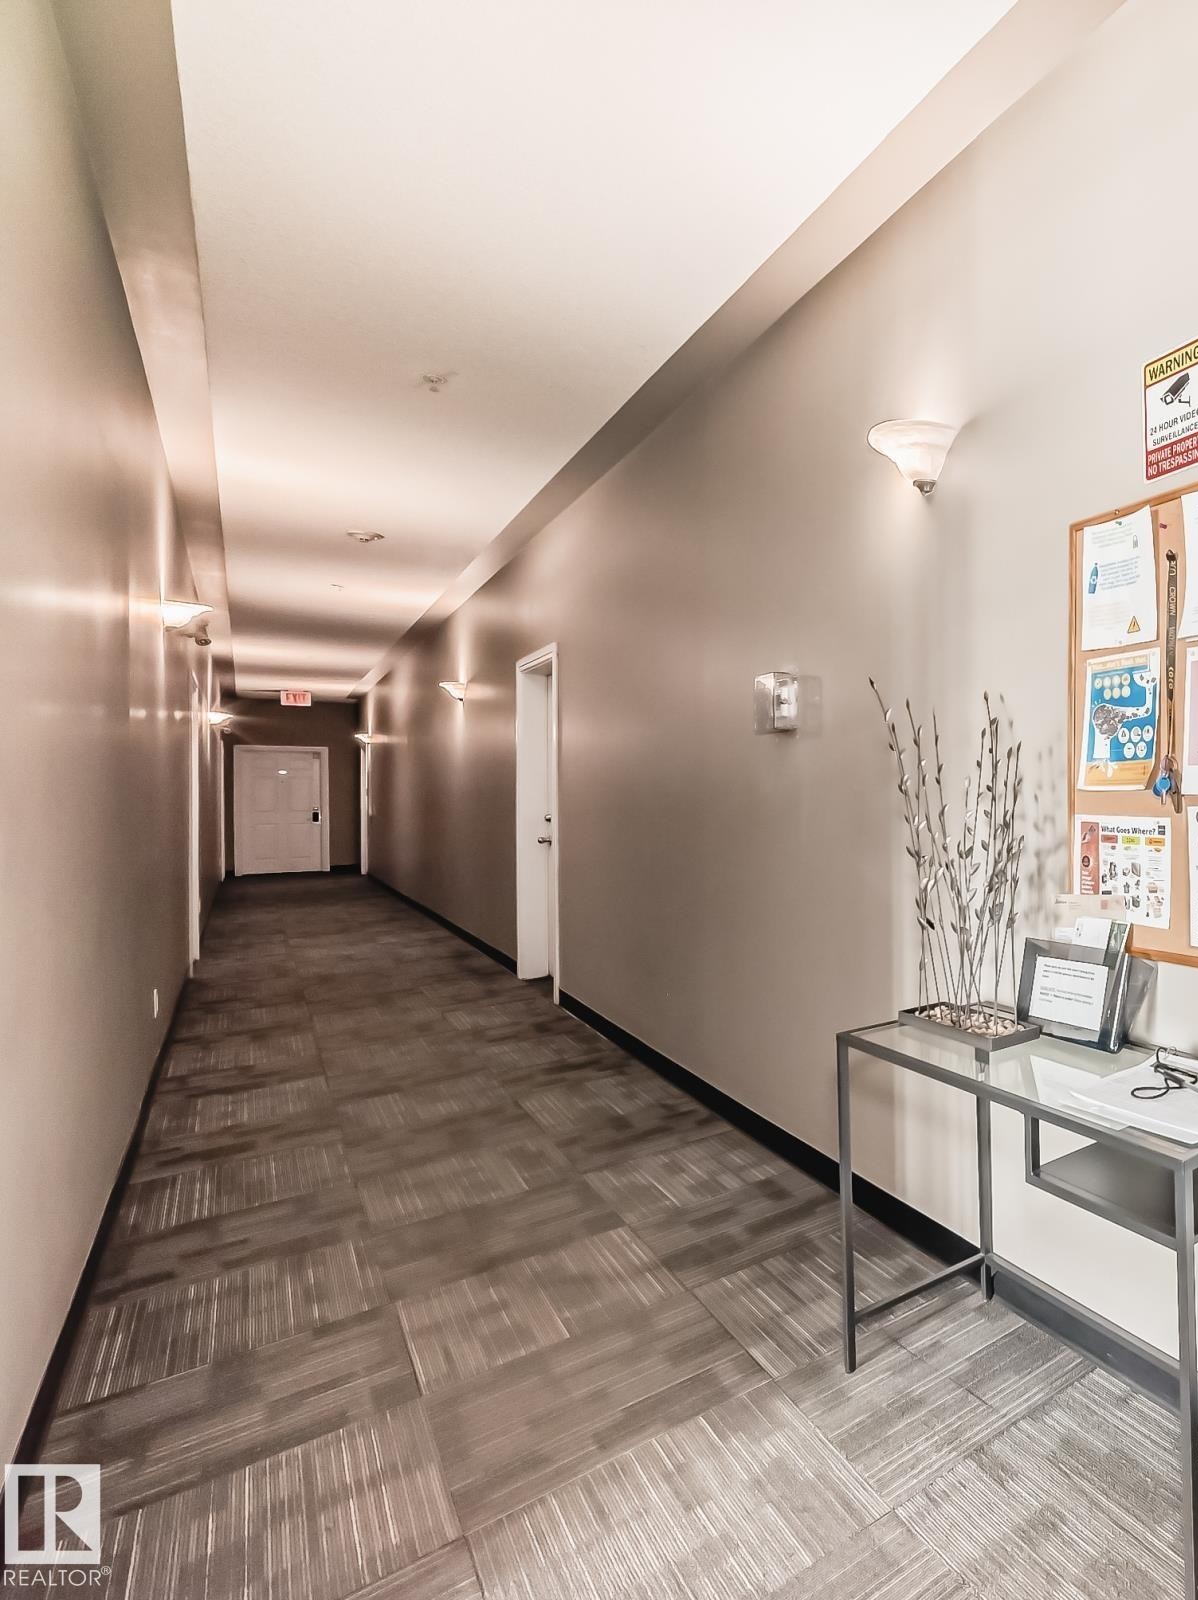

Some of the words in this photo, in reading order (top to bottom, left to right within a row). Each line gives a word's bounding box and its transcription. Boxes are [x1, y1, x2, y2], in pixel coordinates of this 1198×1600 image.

[1149, 426, 1157, 436] 24
[1158, 417, 1178, 433] HOUR
[1152, 421, 1198, 447] SURVEILLANCE
[1147, 446, 1172, 465] PRIVATE
[1147, 464, 1158, 476] NO
[286, 692, 307, 703] EXIT
[1101, 825, 1115, 833] What
[1116, 826, 1130, 834] Goes
[1131, 827, 1156, 835] Where?
